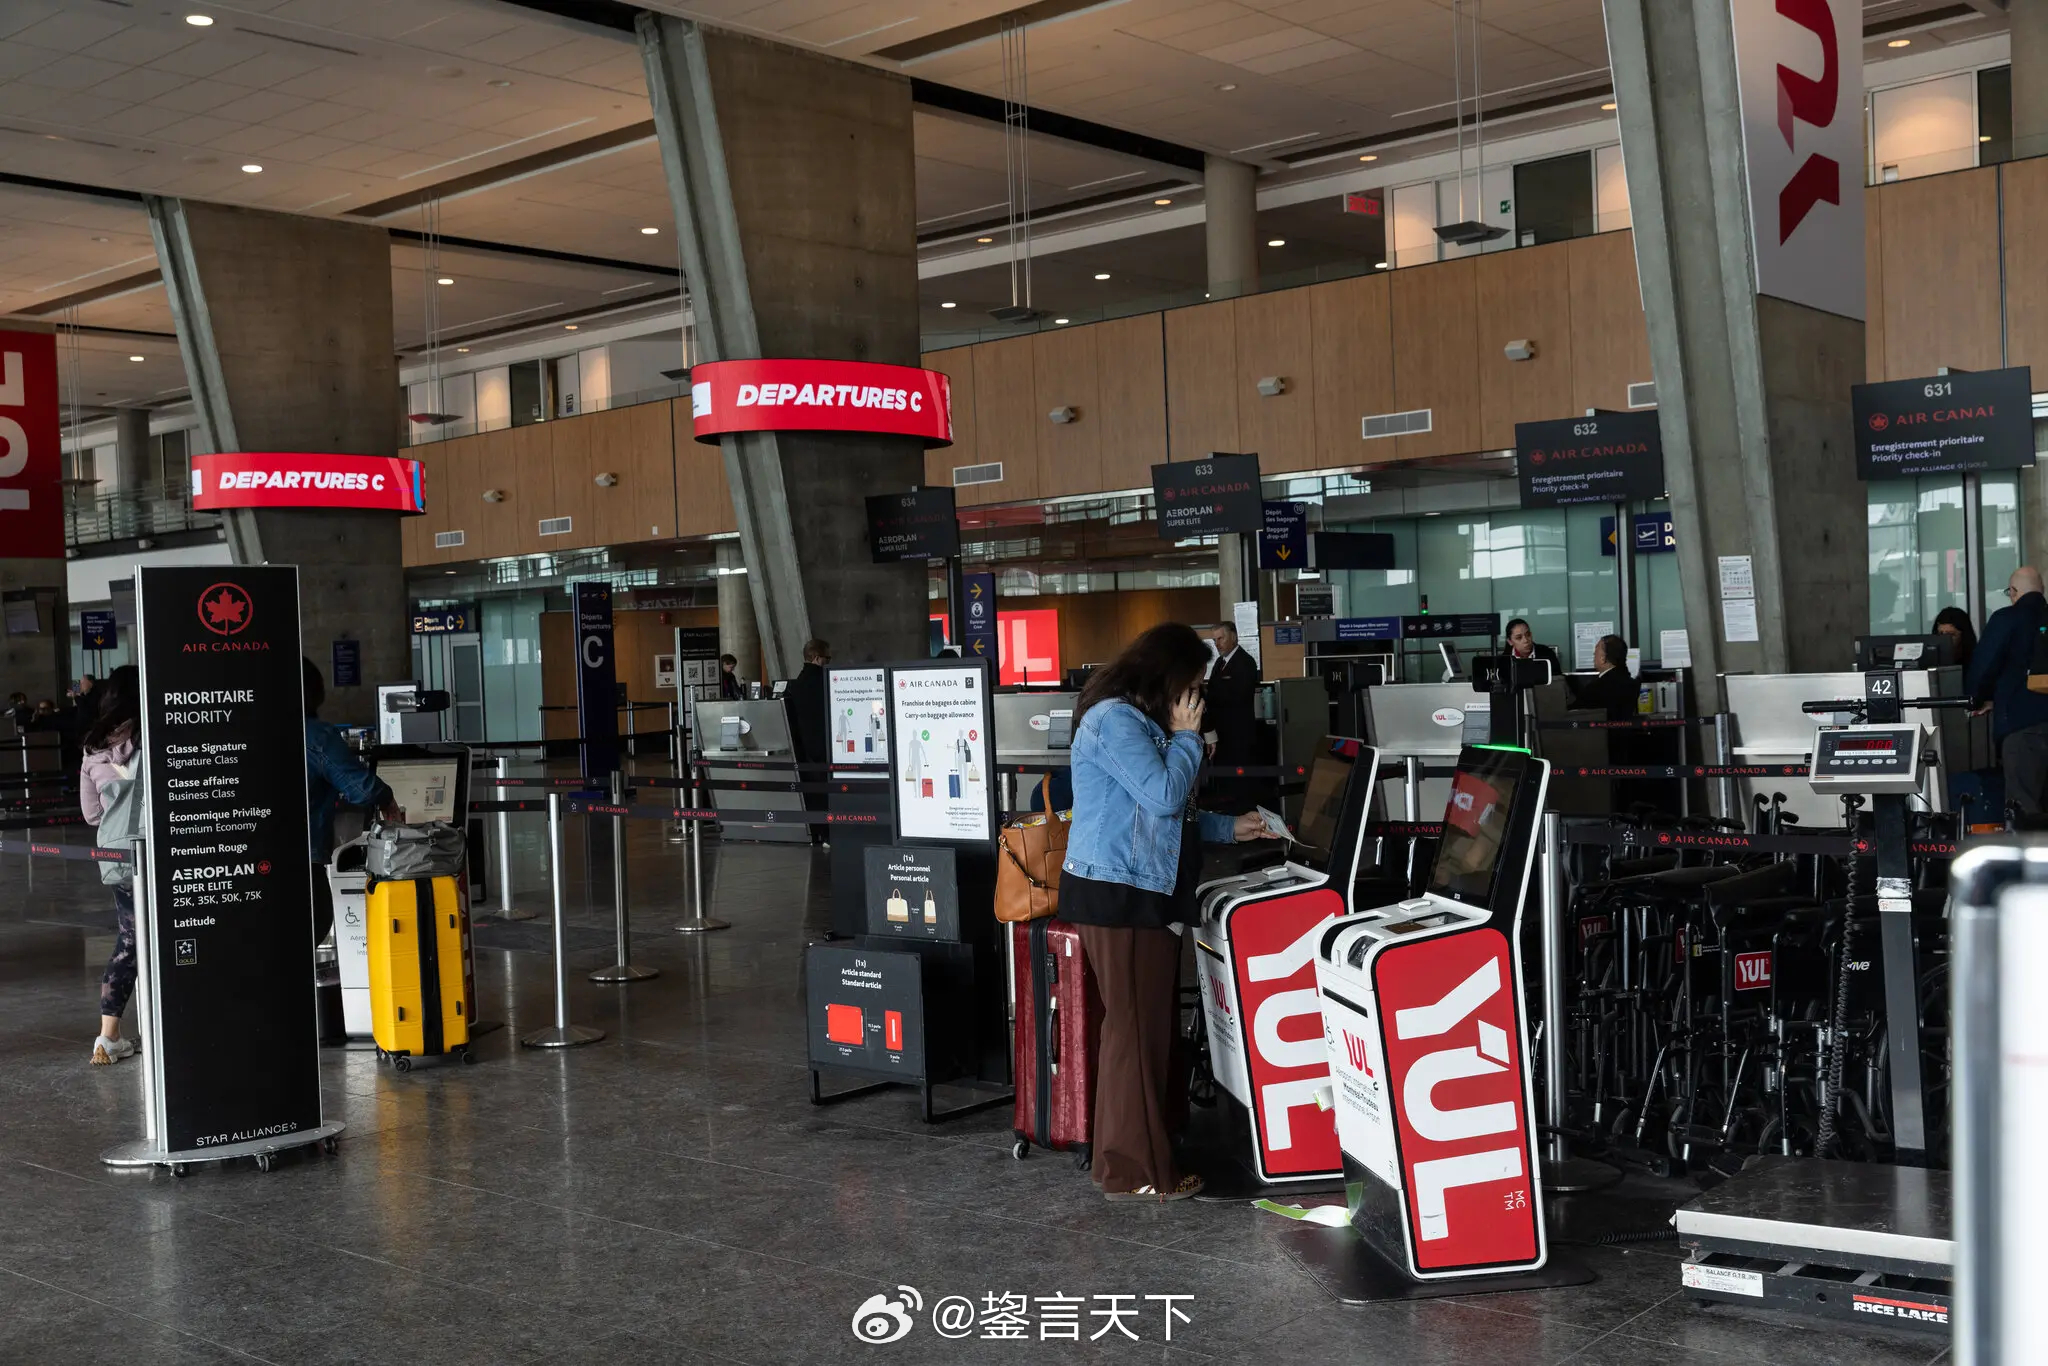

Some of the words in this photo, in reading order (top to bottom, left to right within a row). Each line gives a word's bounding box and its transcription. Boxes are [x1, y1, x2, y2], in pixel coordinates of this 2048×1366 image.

[1924, 383, 1952, 397] 631
[736, 383, 907, 412] DEPARTURES
[911, 391, 922, 412] C
[1896, 412, 1928, 425] AIR
[1573, 423, 1598, 436] 632
[1551, 449, 1577, 460] AIR
[1582, 442, 1648, 457] CANADA
[1871, 439, 1937, 454] Enregistrement
[1939, 435, 1985, 448] prioritaire
[1872, 453, 1904, 463] Priority
[1905, 449, 1941, 460] check-in
[1195, 464, 1213, 476] 633
[219, 471, 368, 490] DEPARTURES
[372, 474, 384, 491] C
[1532, 474, 1585, 484] Enregistrement
[1587, 470, 1623, 480] prioritaire
[1180, 486, 1199, 497] AIR
[1201, 482, 1251, 495] CANADA
[1532, 486, 1558, 494] Priority
[1560, 483, 1589, 491] check-in
[900, 496, 917, 508] 634
[1166, 505, 1214, 518] AEROPLAN
[1166, 519, 1185, 527] SUPER
[879, 534, 918, 544] AEROPLAN
[447, 615, 455, 630] C
[183, 643, 207, 652] AIR
[211, 641, 270, 652] CANADA
[583, 635, 604, 668] C
[924, 679, 958, 687] CANADA
[1872, 680, 1892, 695] 42
[164, 690, 254, 705] PRIORITAIRE
[165, 710, 232, 725] PRIORITY
[905, 712, 926, 720] Carry-on
[928, 711, 948, 719] baggage
[166, 745, 199, 754] Classe
[201, 742, 247, 755] Signature
[167, 757, 212, 769] Signature
[214, 755, 239, 764] Class
[1608, 768, 1647, 776] CANADA
[1726, 767, 1767, 775] CANADA
[168, 778, 200, 788] Classe
[203, 776, 240, 786] affaires
[168, 791, 209, 801] Business
[211, 789, 236, 799] Class
[169, 811, 230, 822] Économique
[232, 807, 271, 818] Privilège
[605, 806, 629, 814] CANADA
[170, 825, 212, 835] Premium
[215, 822, 257, 832] Economy
[1408, 825, 1442, 834] CANAD
[1674, 836, 1695, 844] AIR
[1697, 837, 1750, 847] CANADA
[171, 846, 215, 856] Premium
[218, 844, 248, 854] Rouge
[903, 854, 914, 863] (1x)
[172, 863, 254, 881] AEROPLAN
[888, 863, 905, 871] Article
[890, 874, 912, 882] Personal
[172, 883, 205, 894] SUPER
[207, 880, 233, 891] ELITE
[173, 897, 195, 907] 25K,
[197, 895, 218, 905] 35K,
[221, 893, 242, 902] 50K,
[244, 890, 262, 901] 75K
[174, 915, 216, 928] Latitude
[855, 959, 867, 968] (1x)
[1847, 960, 1870, 971] rive
[841, 968, 859, 976] Article
[859, 970, 882, 979] standard
[1739, 958, 1771, 983] YUL
[841, 979, 864, 988] Standard
[865, 981, 882, 989] article
[1343, 1028, 1374, 1078] YUL
[1395, 956, 1523, 1241] YUL
[196, 1134, 229, 1146] STAR
[231, 1123, 289, 1141] ALLIANCE
[1503, 1192, 1514, 1210] TM
[1515, 1190, 1526, 1208] MC
[1853, 1302, 1895, 1316] RICE
[1898, 1307, 1948, 1324] LAKE
